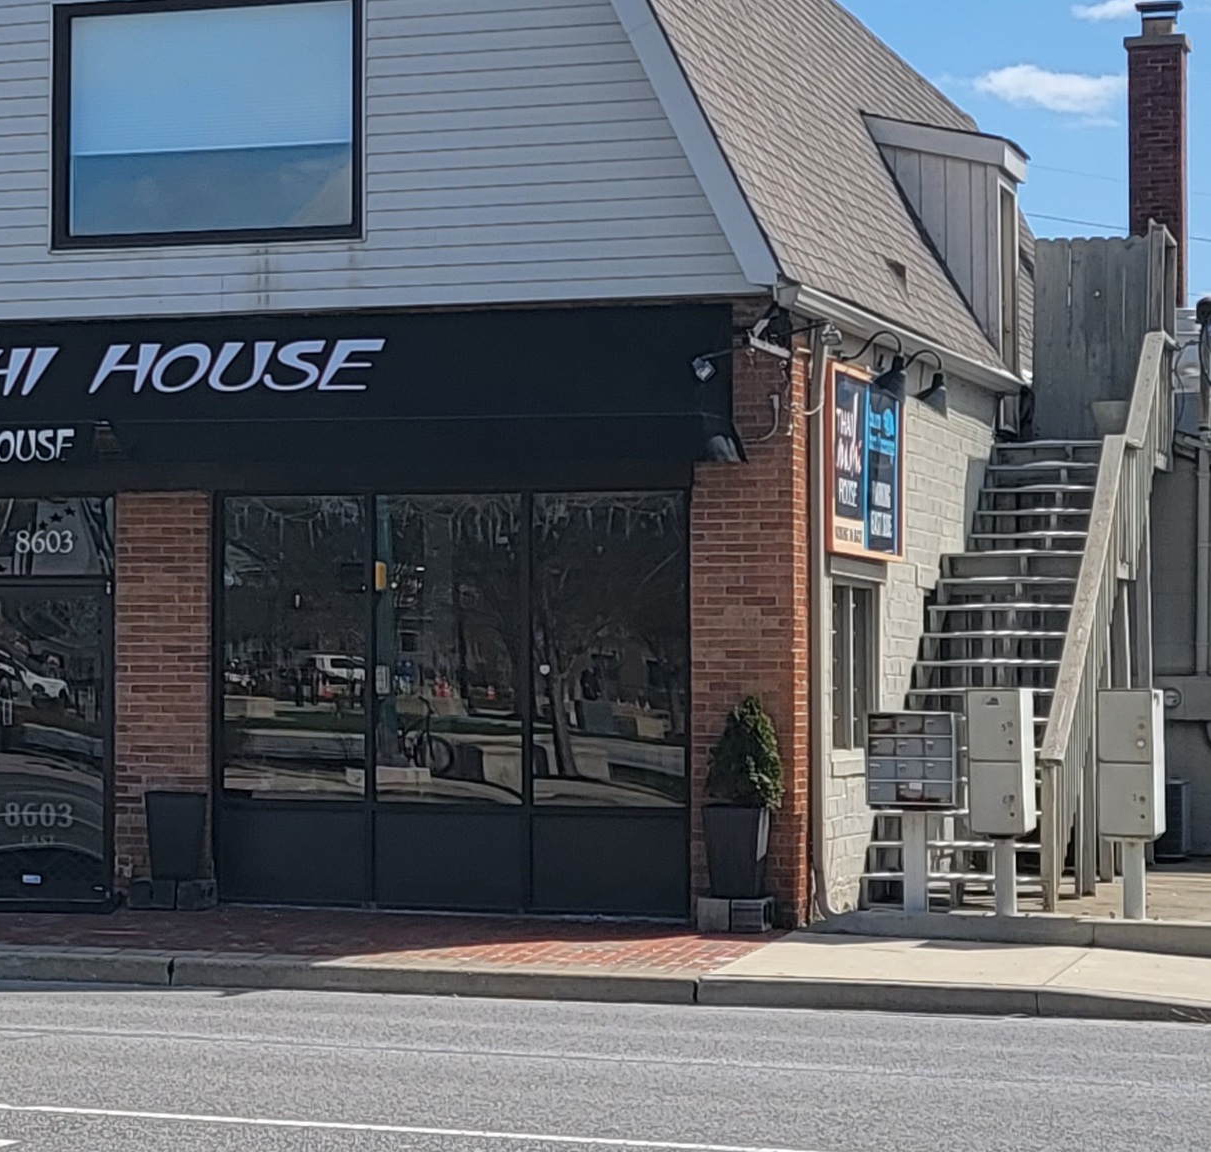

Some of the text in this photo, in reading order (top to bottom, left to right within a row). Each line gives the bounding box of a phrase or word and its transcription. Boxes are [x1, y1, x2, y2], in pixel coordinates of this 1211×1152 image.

[89, 339, 386, 394] HOUSE
[15, 529, 74, 554] 8603
[5, 802, 73, 827] 8603
